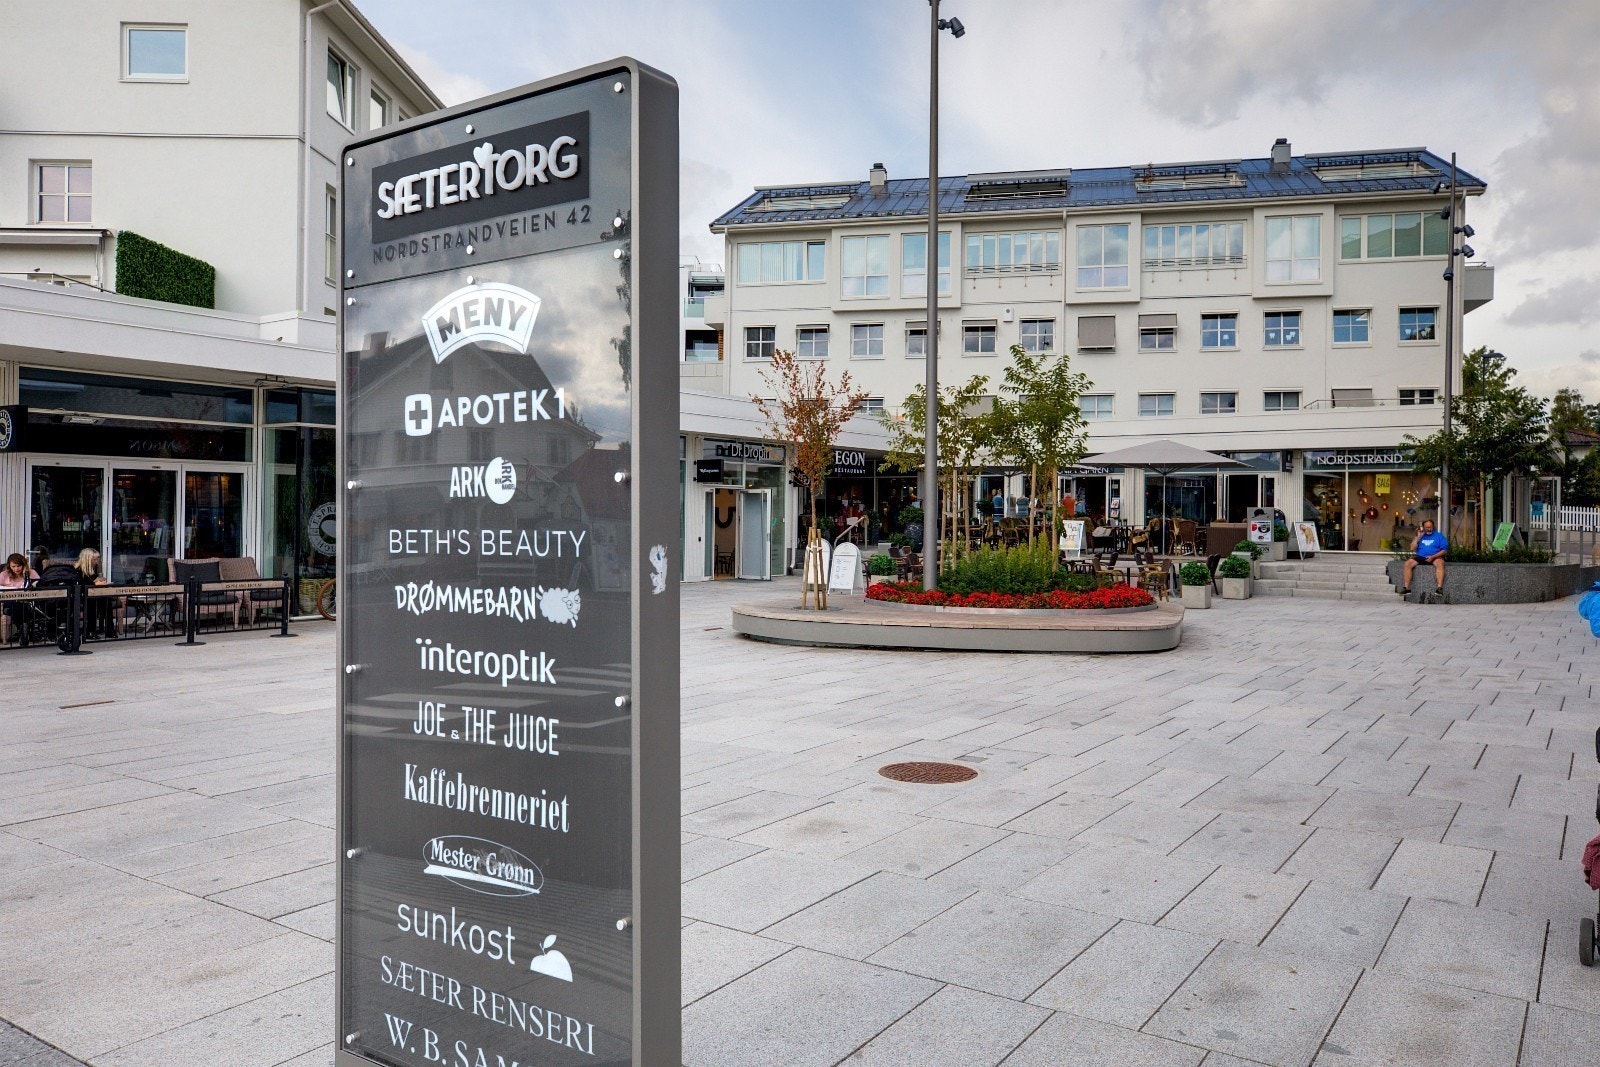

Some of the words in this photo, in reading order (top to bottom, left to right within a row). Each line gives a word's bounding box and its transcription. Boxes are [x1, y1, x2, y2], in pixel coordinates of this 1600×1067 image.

[377, 136, 579, 219] SÆTERTORG
[373, 210, 557, 265] NORDSTRANDVEIEN
[566, 204, 592, 225] 42
[434, 296, 527, 344] MENY
[450, 465, 486, 498] ARK
[834, 467, 866, 475] RESTAURANT
[835, 450, 866, 466] EGON
[1317, 453, 1403, 465] NORDSTRAND
[388, 529, 471, 556] BETH'S
[481, 529, 587, 558] BEAUTY
[394, 579, 537, 623] DRØMMEBARN
[413, 700, 446, 738] JOE
[450, 729, 460, 740] &
[461, 706, 497, 745] THE
[503, 712, 560, 756] JUICE
[403, 762, 570, 833] Kaffebrenneriet
[430, 838, 481, 872] Mester
[485, 852, 534, 886] Grønn
[397, 903, 516, 965] sunkost
[381, 955, 465, 1011] SÆTER
[471, 985, 596, 1056] RENSERI
